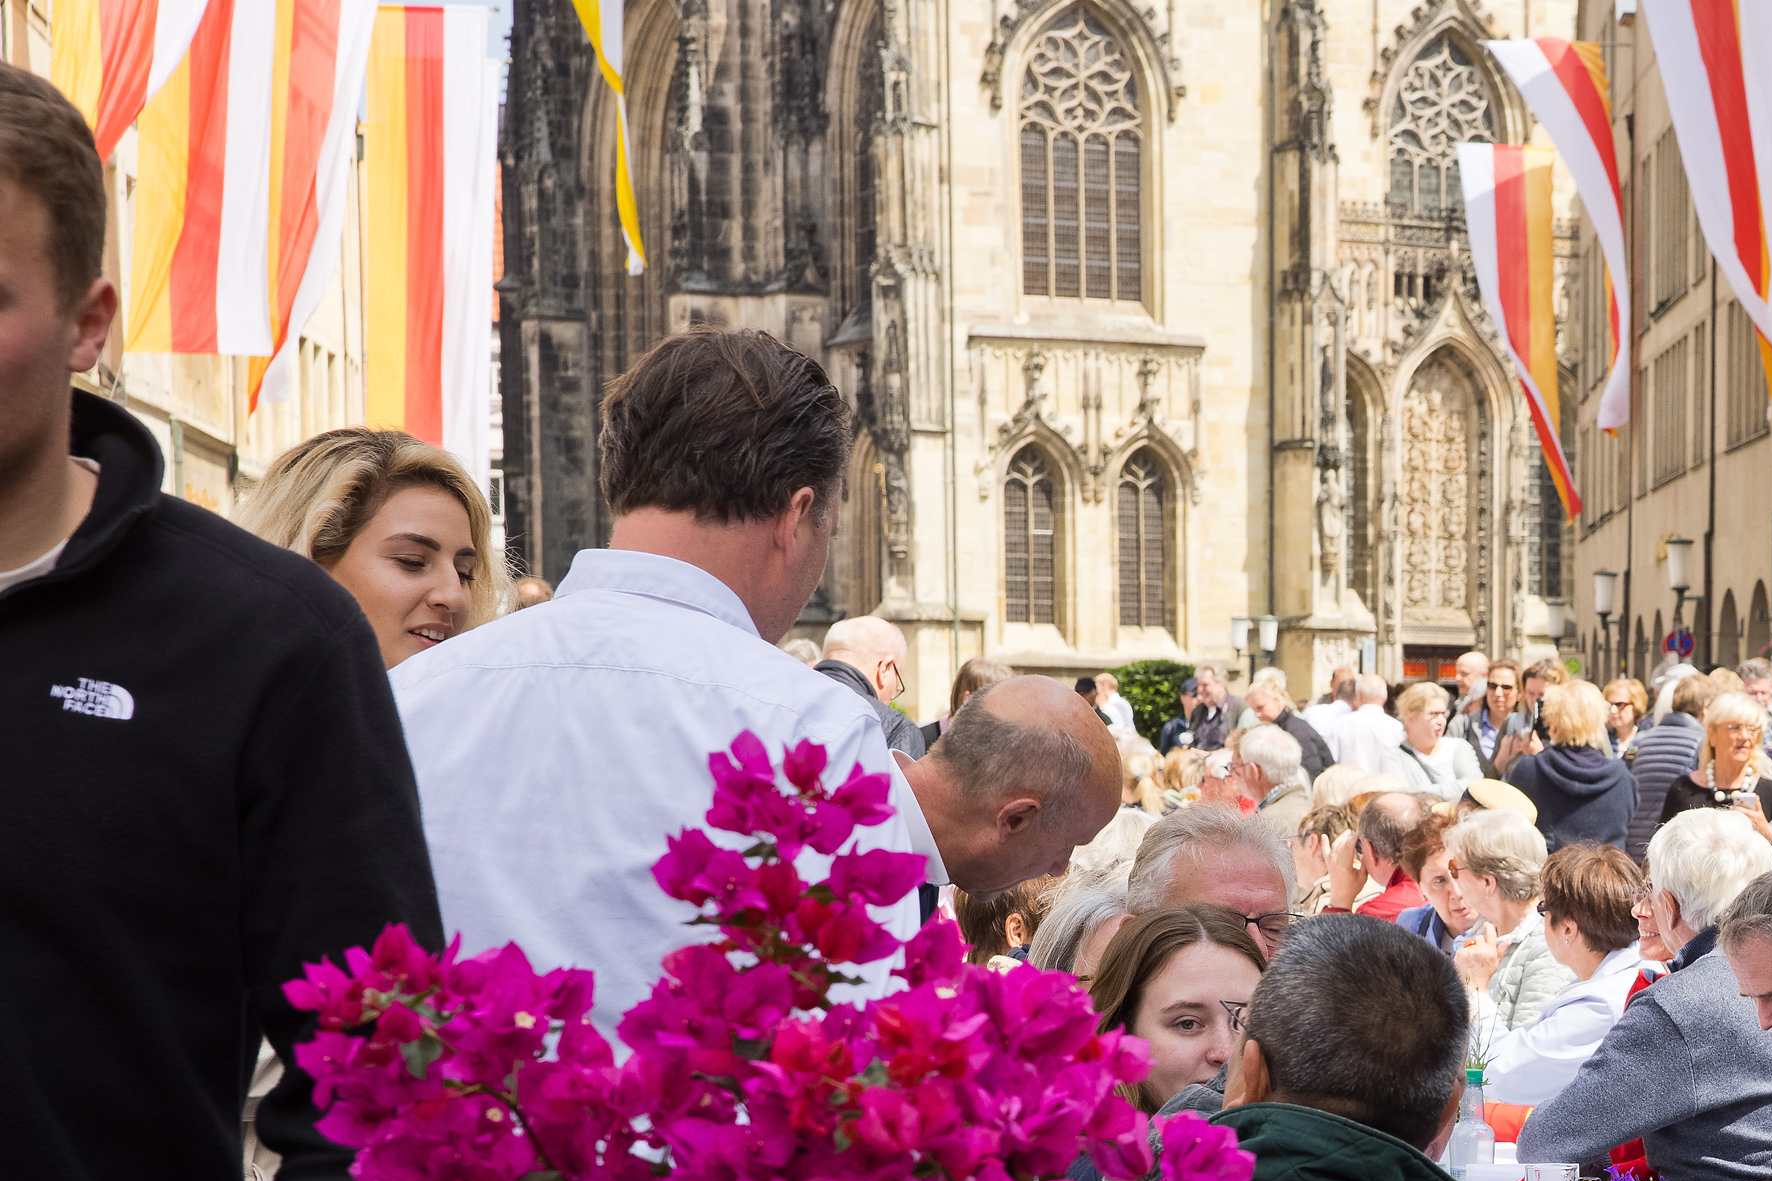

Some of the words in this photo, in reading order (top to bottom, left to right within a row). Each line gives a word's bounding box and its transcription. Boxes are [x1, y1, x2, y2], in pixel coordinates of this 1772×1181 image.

[50, 684, 109, 705] NORTH
[77, 677, 112, 695] THE
[62, 699, 106, 717] FACE
